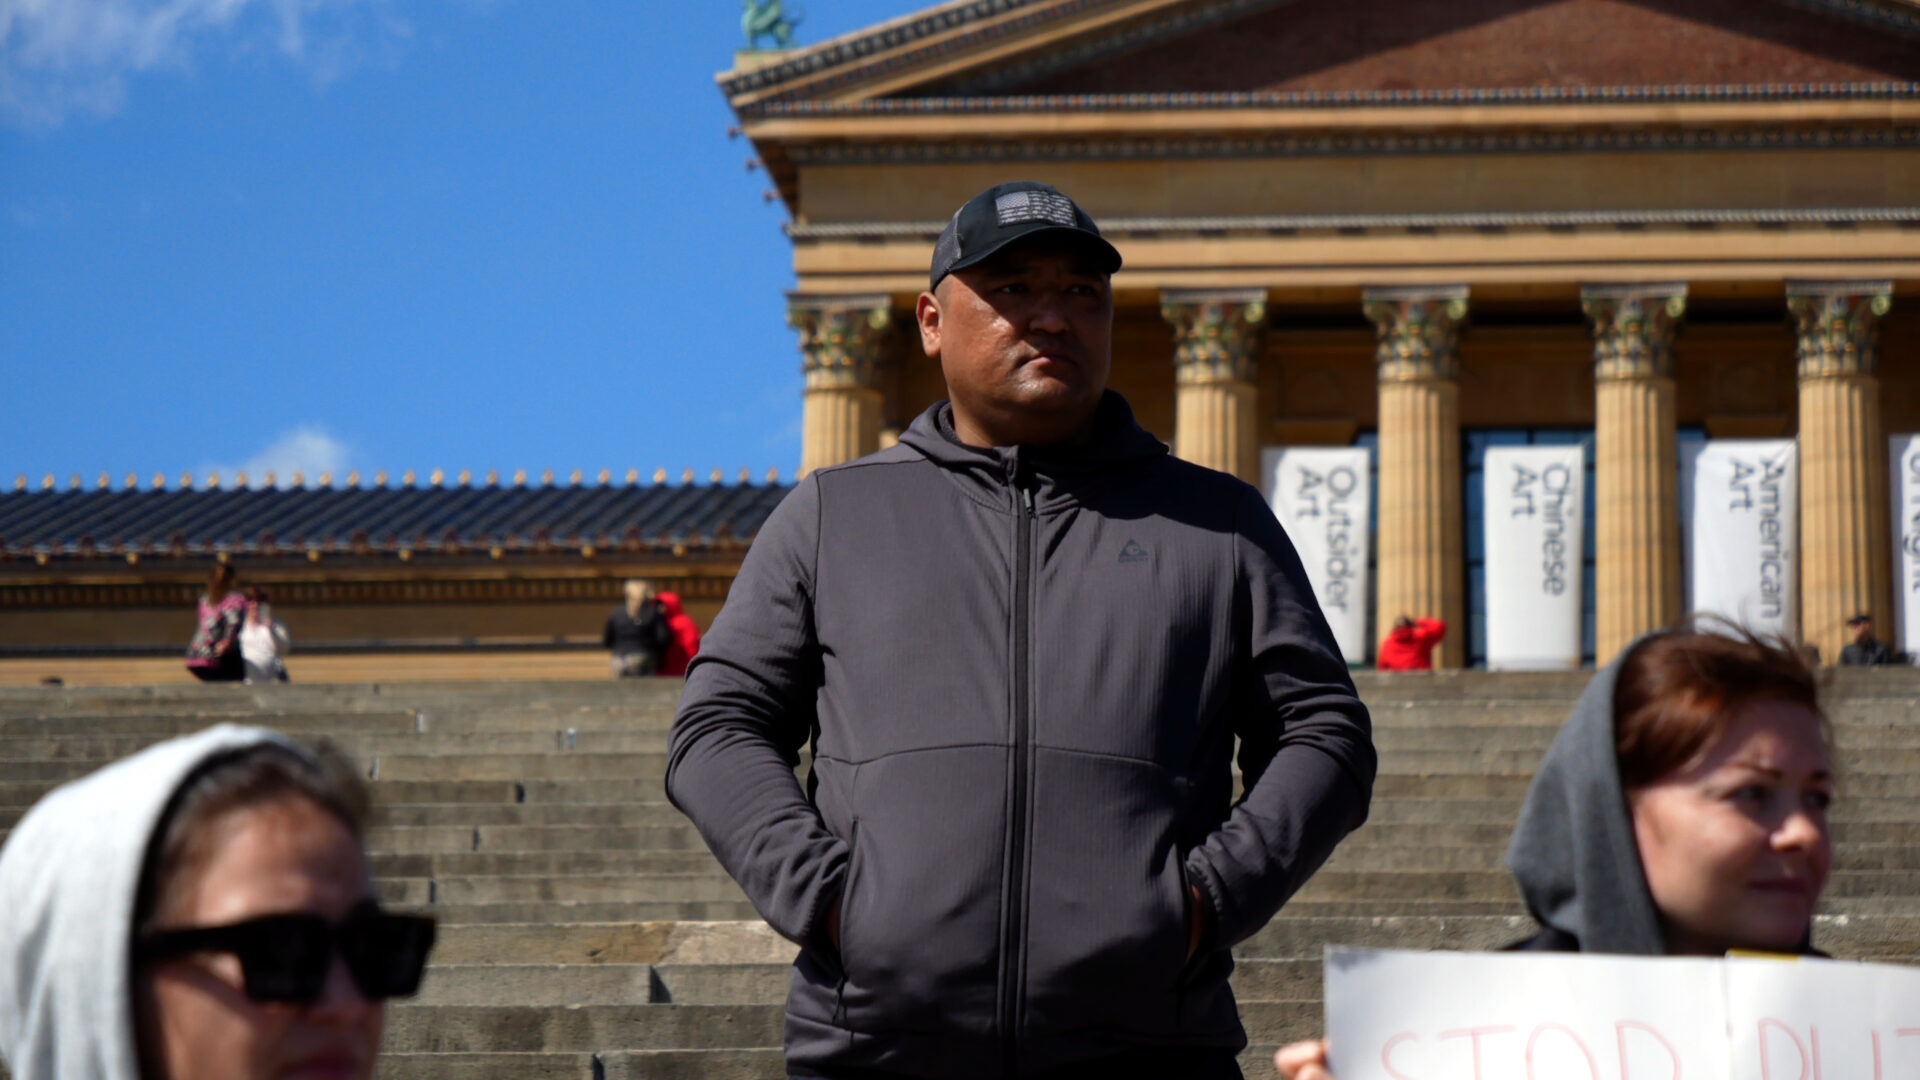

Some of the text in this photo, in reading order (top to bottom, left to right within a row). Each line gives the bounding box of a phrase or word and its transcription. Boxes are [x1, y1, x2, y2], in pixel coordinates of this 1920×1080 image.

[1297, 464, 1324, 521] Art
[1511, 463, 1538, 519] Art
[1542, 463, 1574, 596] Chinese
[1729, 456, 1755, 512] Art
[1327, 465, 1358, 614] Outsider
[1759, 455, 1789, 619] American
